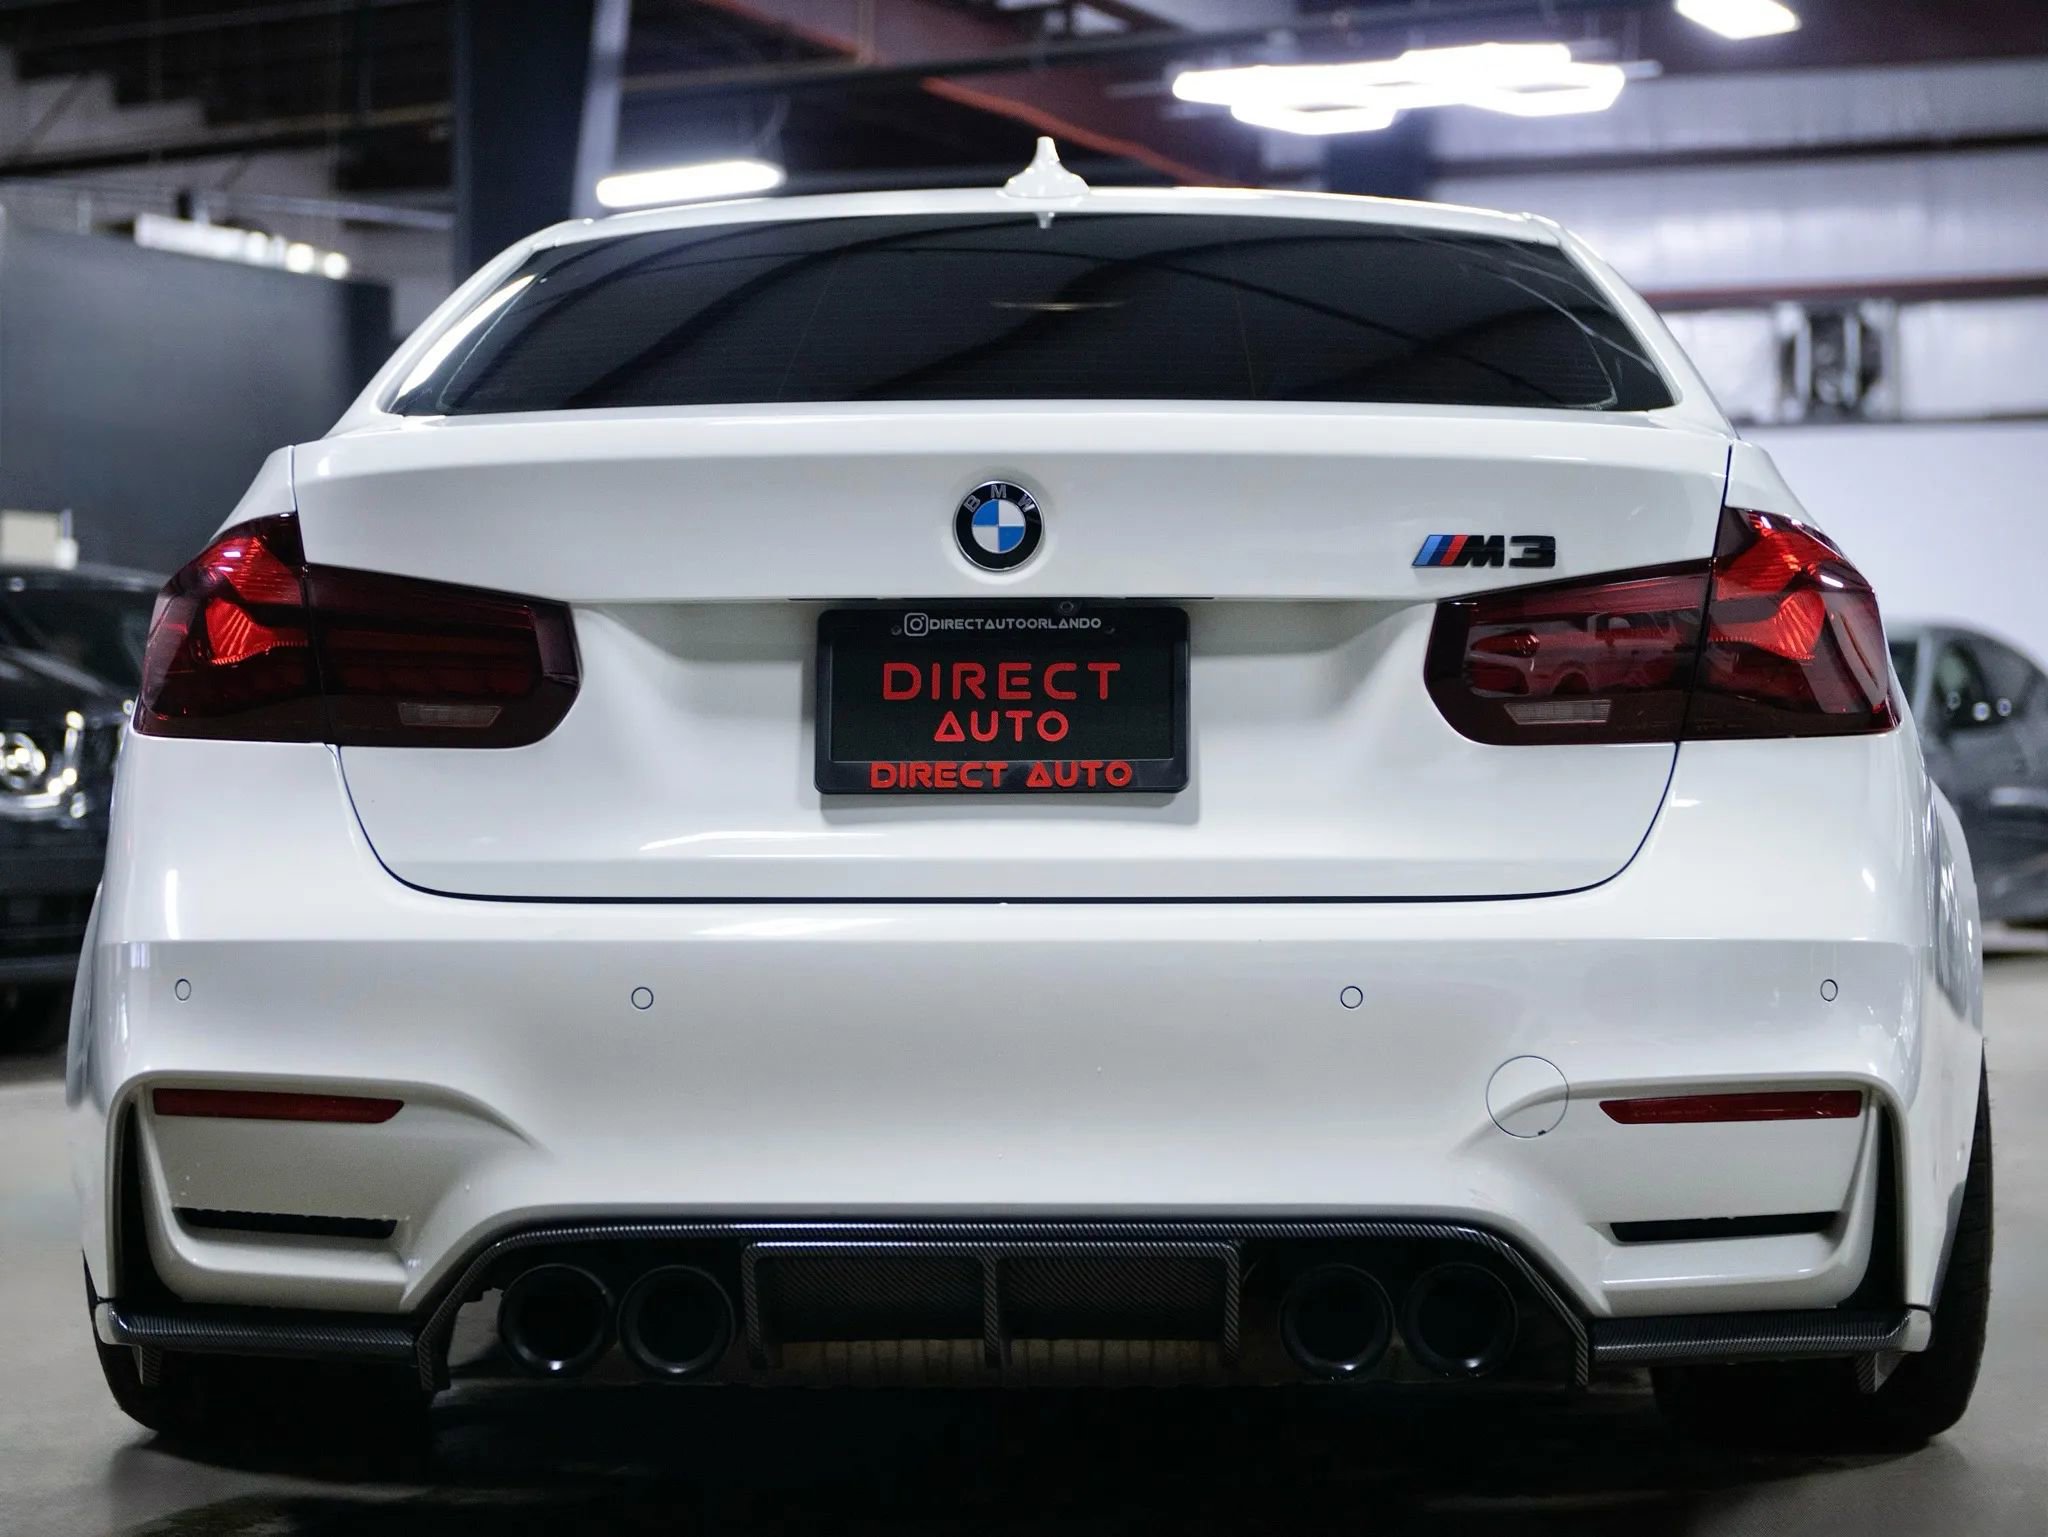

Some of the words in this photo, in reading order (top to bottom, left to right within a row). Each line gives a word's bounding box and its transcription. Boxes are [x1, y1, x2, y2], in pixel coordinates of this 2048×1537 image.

[963, 484, 1036, 513] BMW
[1450, 534, 1556, 567] M3
[929, 617, 1102, 630] DIRECTAUTOORLANDO
[883, 663, 1121, 700] DIRECT
[934, 710, 1069, 742] AUTO
[871, 761, 1008, 788] DIRECT
[1026, 761, 1133, 788] AUTO
